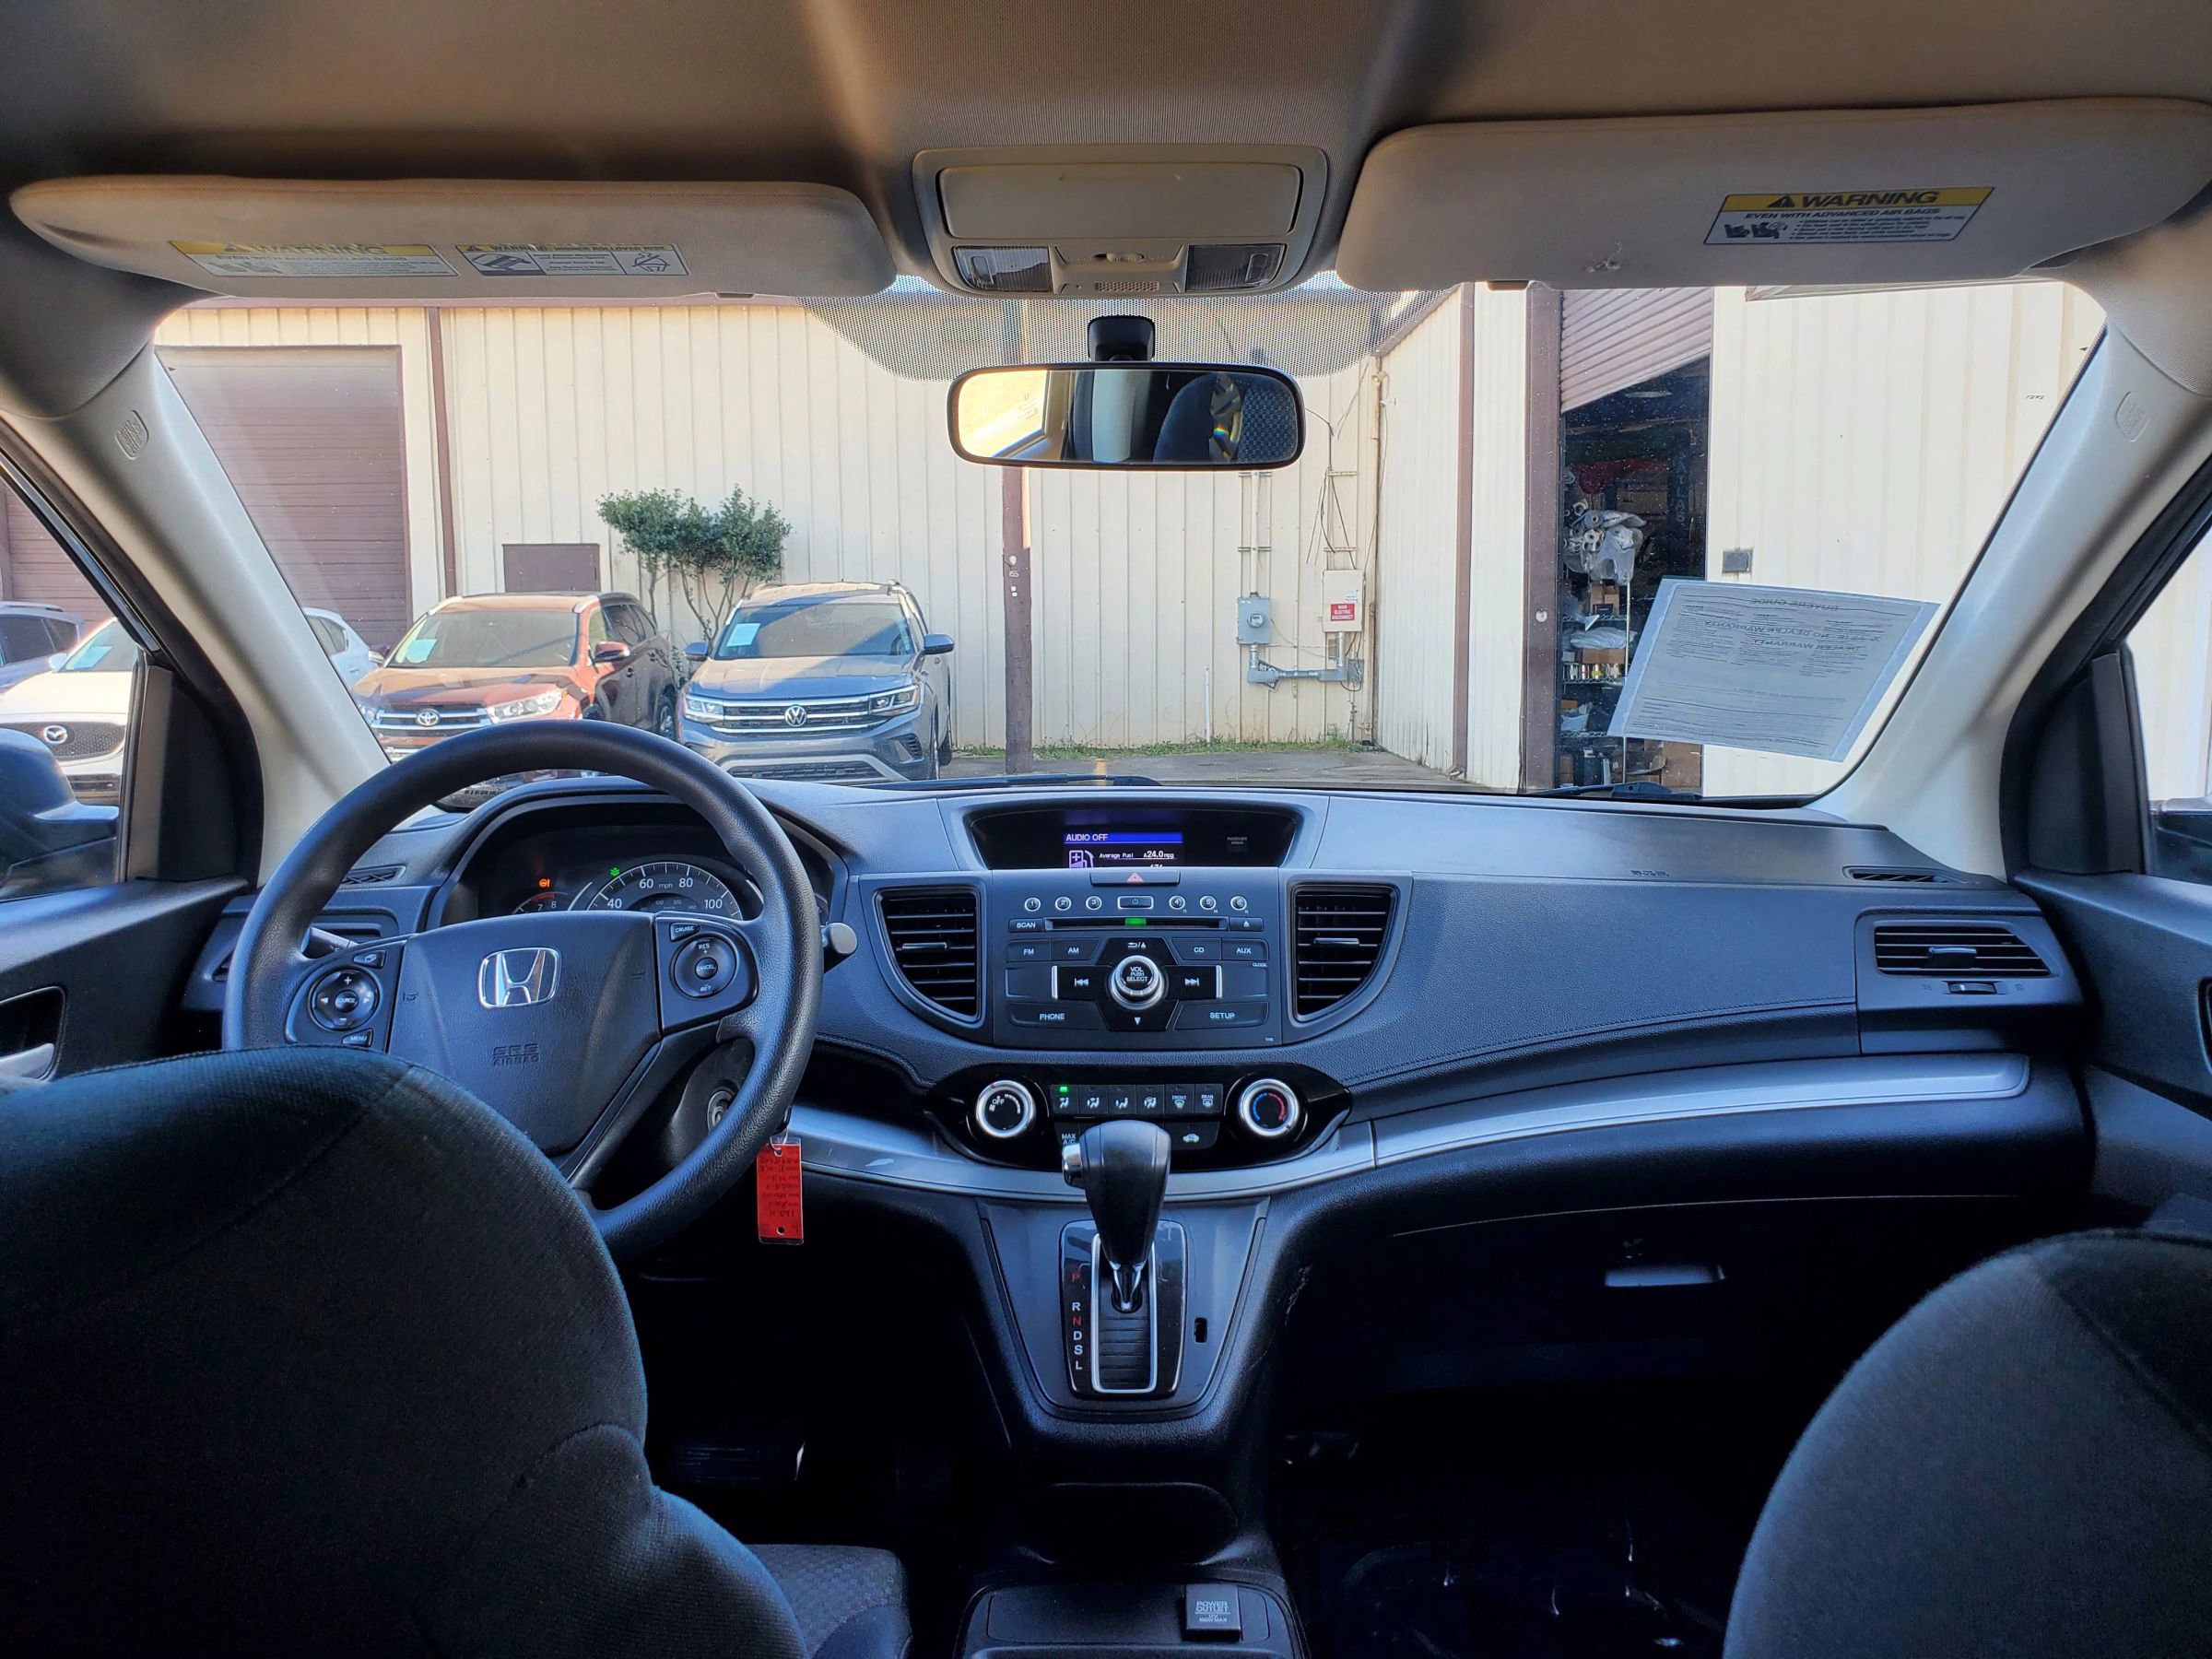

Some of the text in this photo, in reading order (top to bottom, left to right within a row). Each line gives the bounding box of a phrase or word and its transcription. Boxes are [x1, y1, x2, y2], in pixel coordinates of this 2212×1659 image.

[1801, 190, 1943, 208] WARNING
[1813, 210, 1879, 218] ADVANCED
[1065, 833, 1109, 841] AUDIO OFF
[639, 877, 654, 889] 60
[678, 877, 693, 888] 80
[606, 898, 623, 909] 40
[704, 899, 723, 910] 100
[1039, 1013, 1065, 1021] PHONE
[992, 1097, 1005, 1105] OFF
[1071, 1272, 1080, 1282] P
[1072, 1301, 1081, 1312] R
[1072, 1316, 1081, 1325] N
[1073, 1331, 1083, 1341] D
[1074, 1345, 1083, 1355] S
[1075, 1360, 1083, 1370] L
